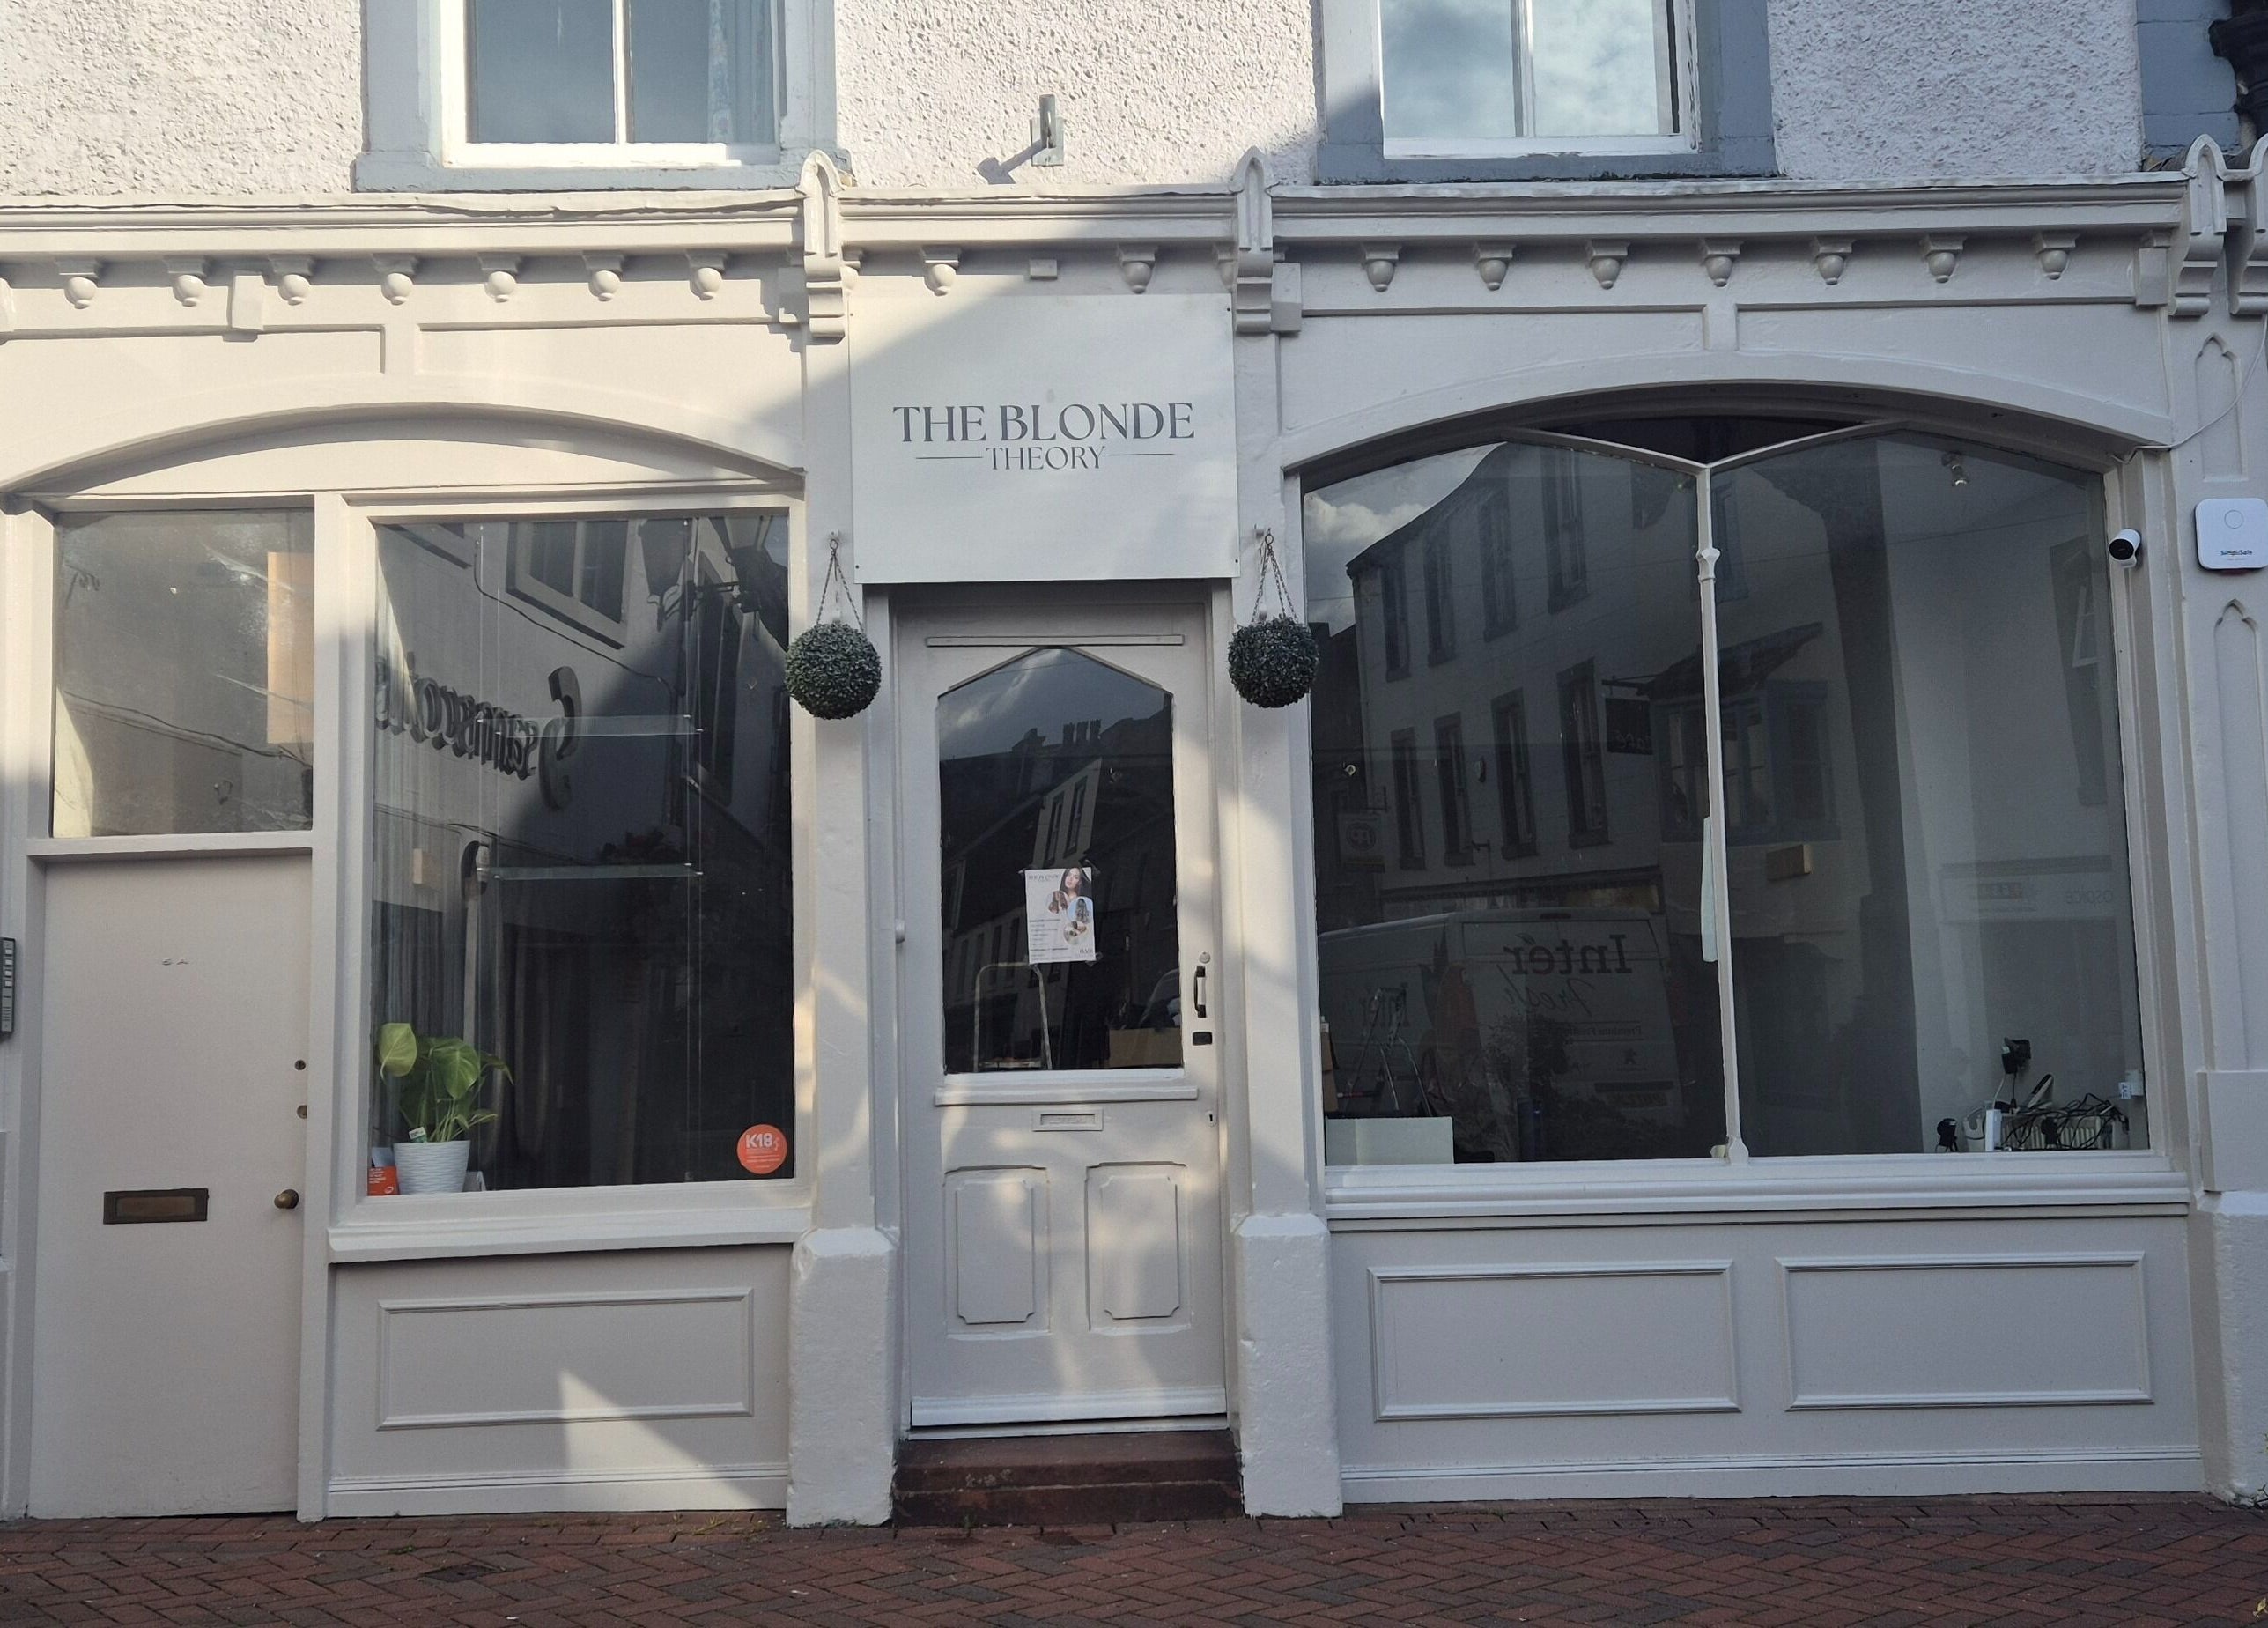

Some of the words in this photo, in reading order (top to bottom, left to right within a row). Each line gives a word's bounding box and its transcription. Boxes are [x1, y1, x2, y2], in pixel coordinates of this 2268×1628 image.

[892, 404, 987, 442] THE
[999, 402, 1195, 441] BLONDE
[985, 445, 1106, 470] THEORY
[745, 1132, 773, 1148] K18
